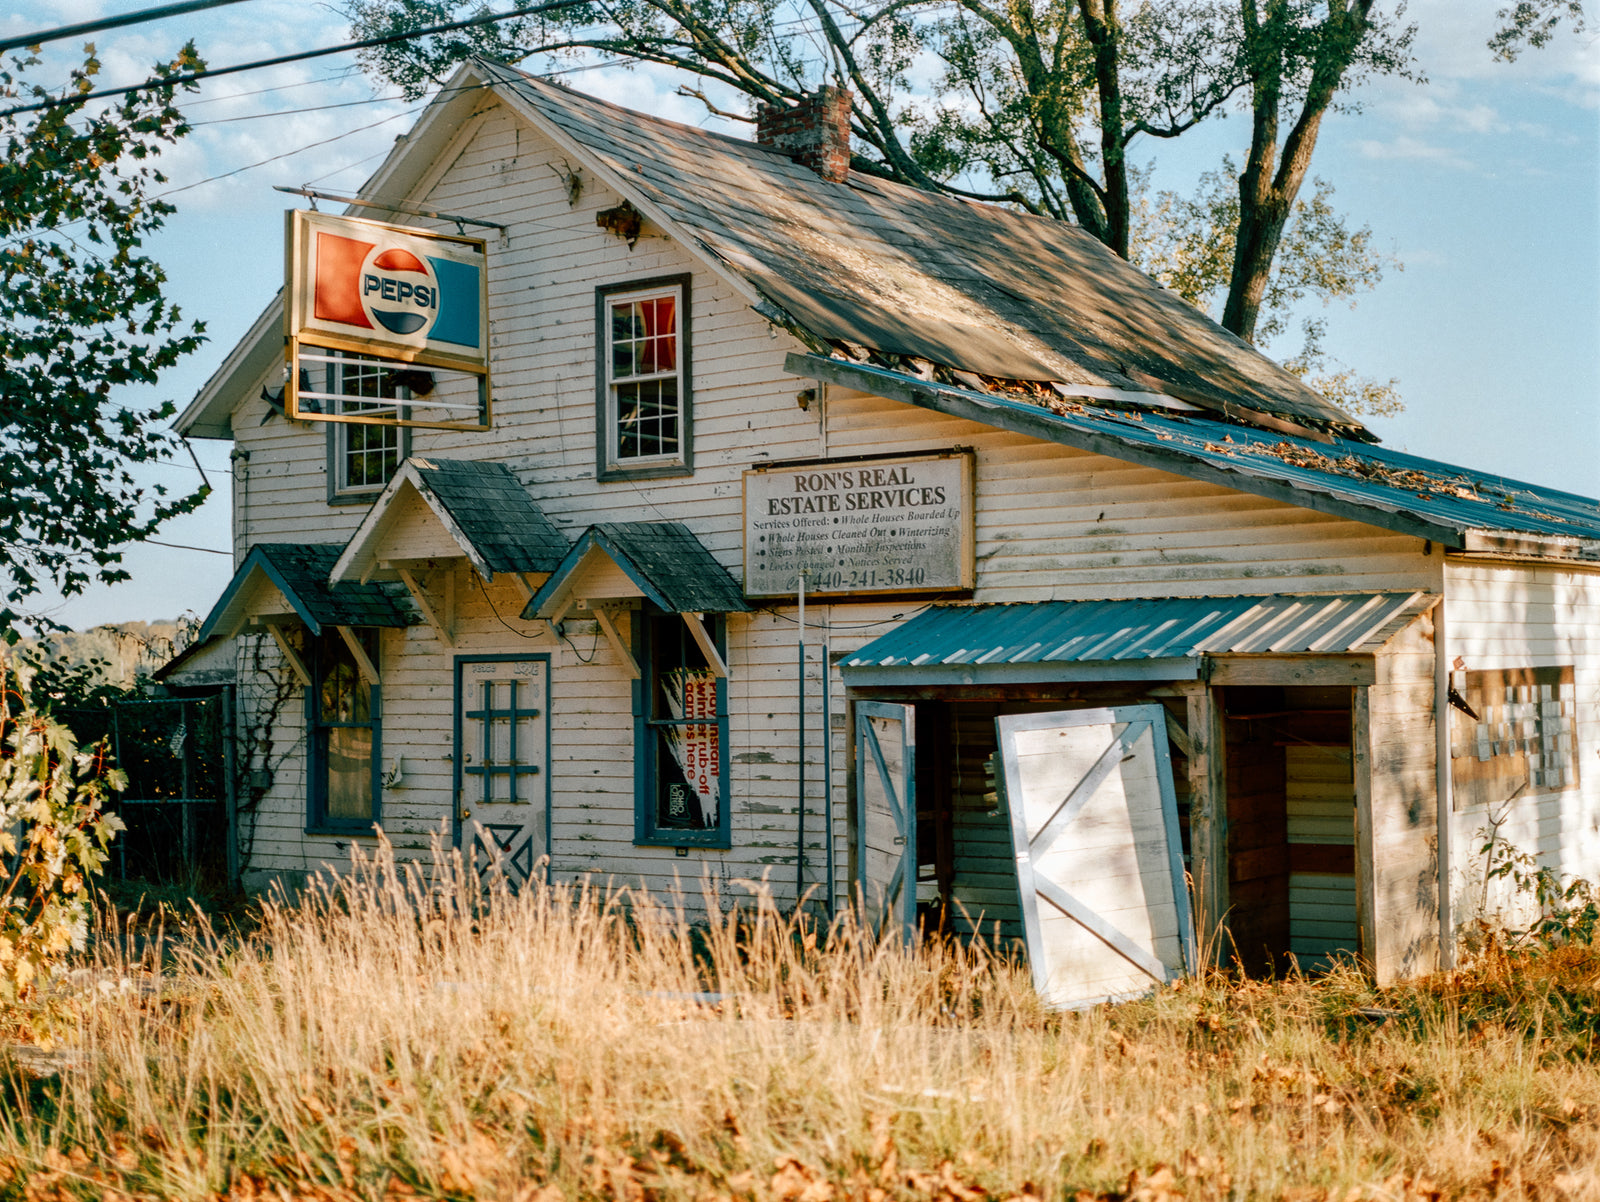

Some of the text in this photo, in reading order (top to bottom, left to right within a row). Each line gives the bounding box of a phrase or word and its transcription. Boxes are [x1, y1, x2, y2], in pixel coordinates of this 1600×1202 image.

[364, 274, 436, 309] PEPSI
[794, 467, 915, 492] RON'S REAL
[768, 486, 946, 516] ESTATE SERVICES
[753, 507, 960, 530] Services Offered: Whole Houses Boarded Up
[768, 526, 951, 543] Whole Houses Cleaned Out Winterizing
[768, 547, 793, 558] Signs
[837, 542, 873, 555] Monthly
[875, 540, 927, 553] Inspections
[768, 555, 914, 572] Locks Changed Notices Served
[813, 567, 925, 588] 440-241-3840
[697, 682, 710, 795] winner rub-off
[686, 743, 697, 780] here
